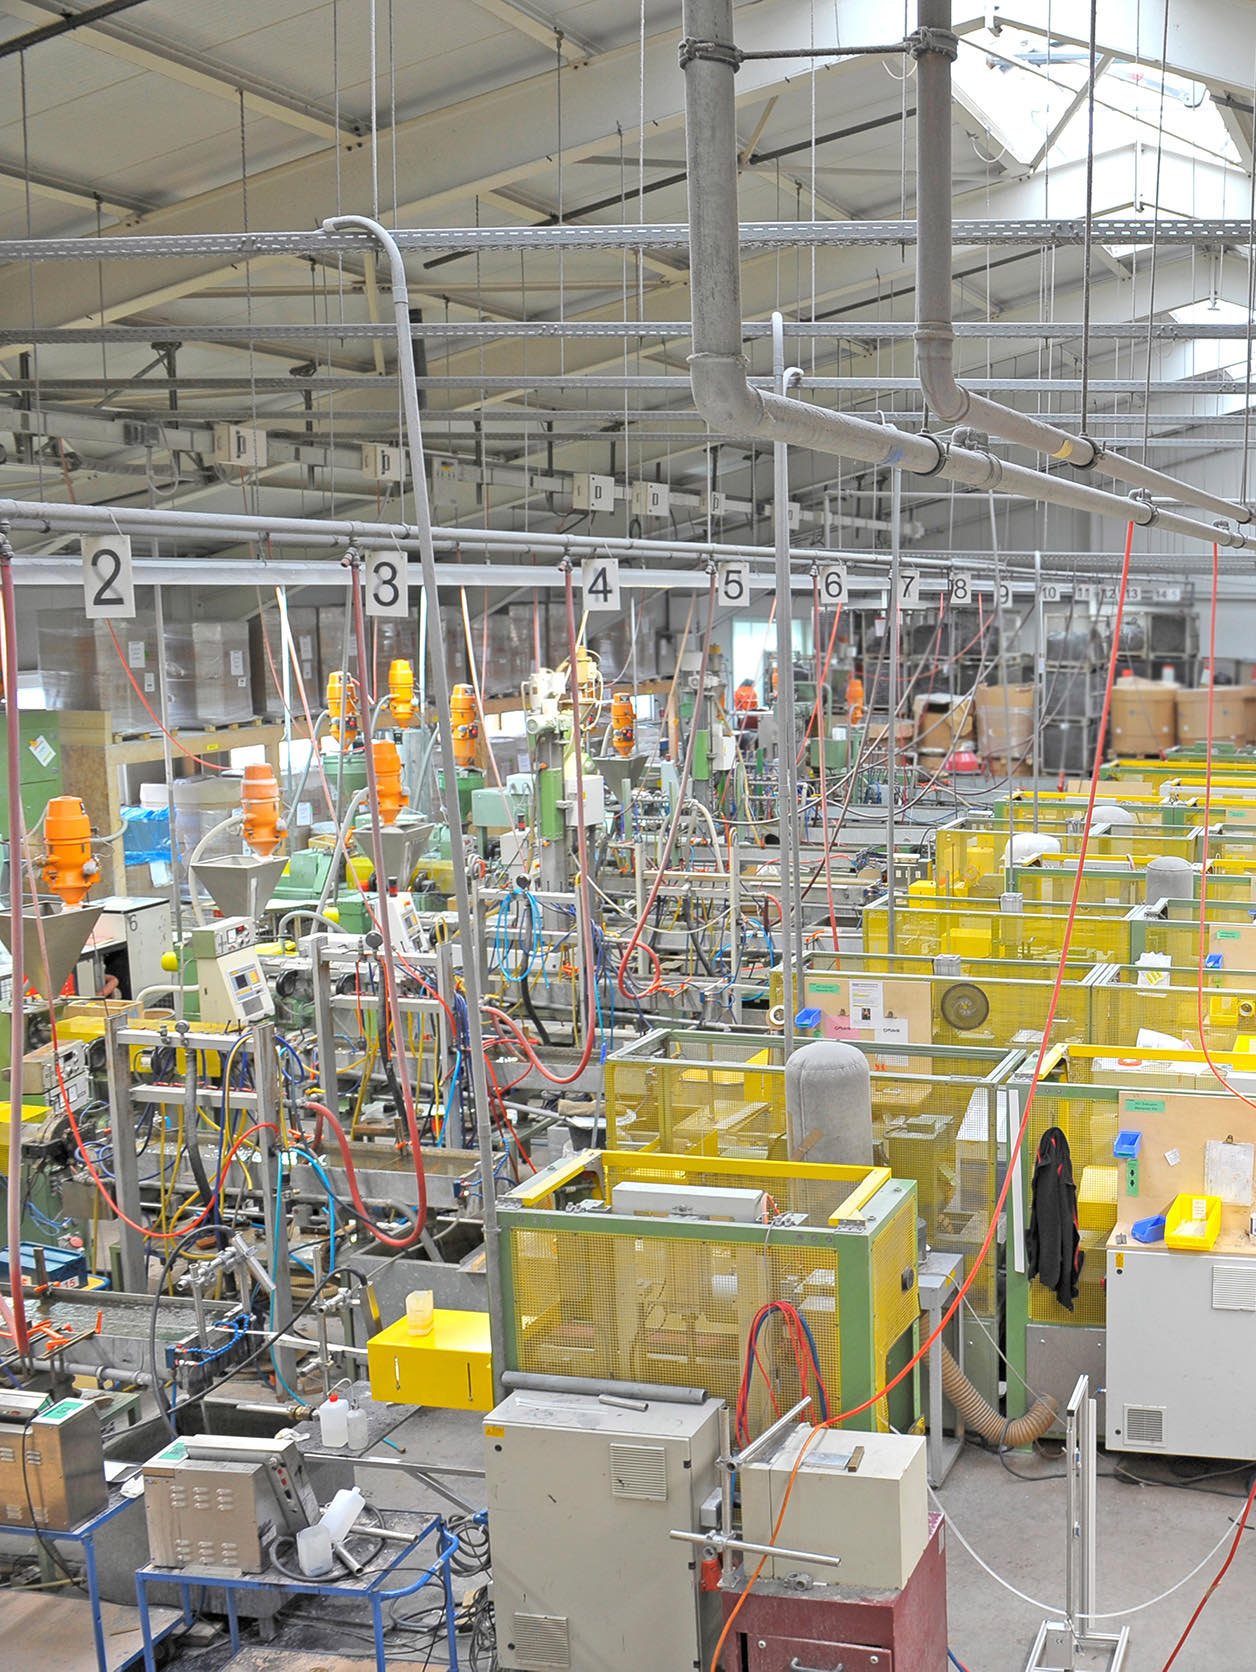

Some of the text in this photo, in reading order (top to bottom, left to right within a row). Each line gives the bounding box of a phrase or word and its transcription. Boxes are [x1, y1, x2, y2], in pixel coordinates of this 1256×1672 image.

[91, 549, 124, 605] 2
[373, 561, 399, 607] 3
[588, 567, 612, 602] 4
[724, 570, 743, 599] 5
[825, 571, 842, 598] 6
[900, 575, 915, 598] 7
[954, 578, 967, 599] 8
[999, 584, 1009, 604] 9
[1042, 586, 1057, 599] 10
